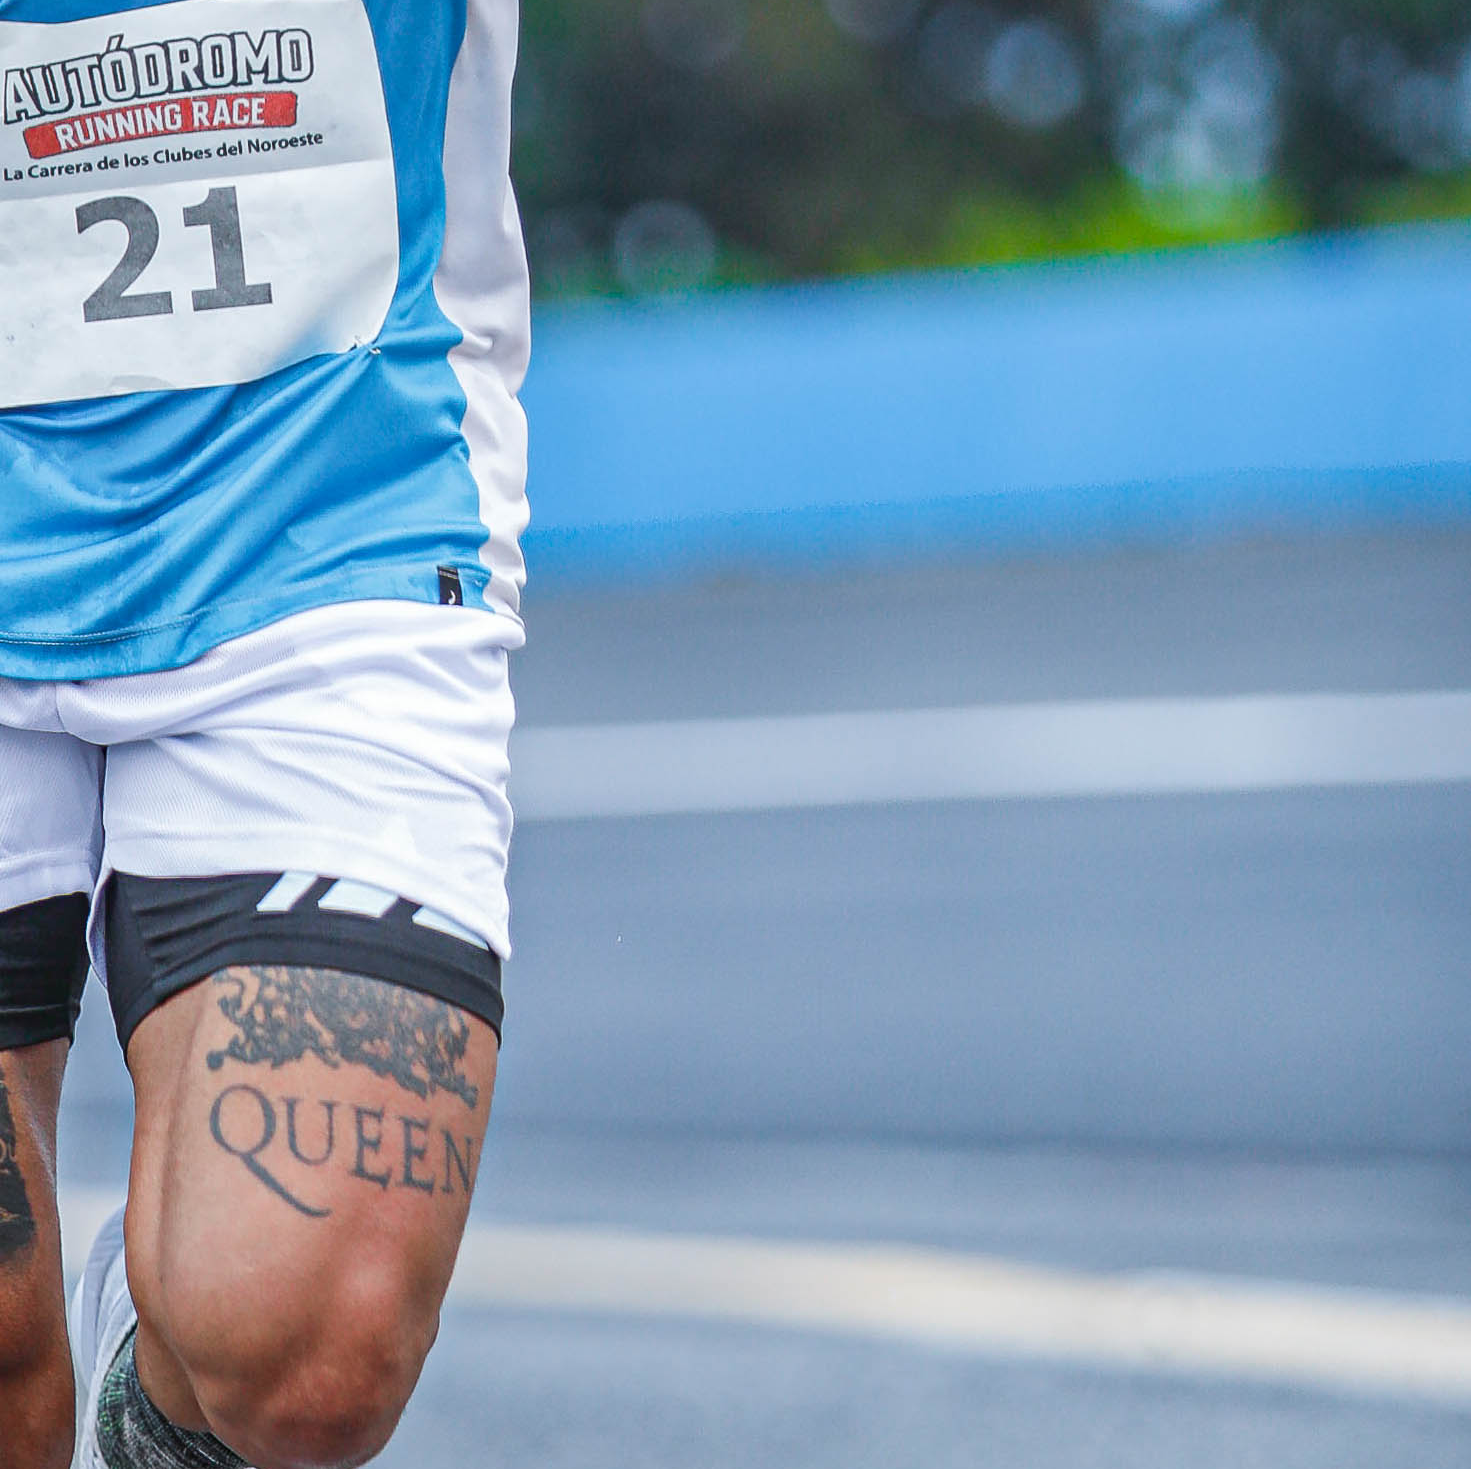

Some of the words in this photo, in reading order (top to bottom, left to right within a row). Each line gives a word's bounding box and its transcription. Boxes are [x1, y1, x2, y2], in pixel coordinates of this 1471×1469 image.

[3, 29, 314, 124] AUTÓDROMO
[54, 103, 182, 152] RUNNING
[191, 96, 266, 127] RACE
[3, 167, 23, 181] La
[28, 160, 93, 179] Carrera
[97, 155, 120, 171] de
[124, 152, 149, 168] los
[153, 146, 212, 165] Clubes
[216, 143, 243, 159] del
[247, 132, 324, 154] Noroeste
[74, 184, 274, 323] 21
[209, 1083, 479, 1218] QUEEN
